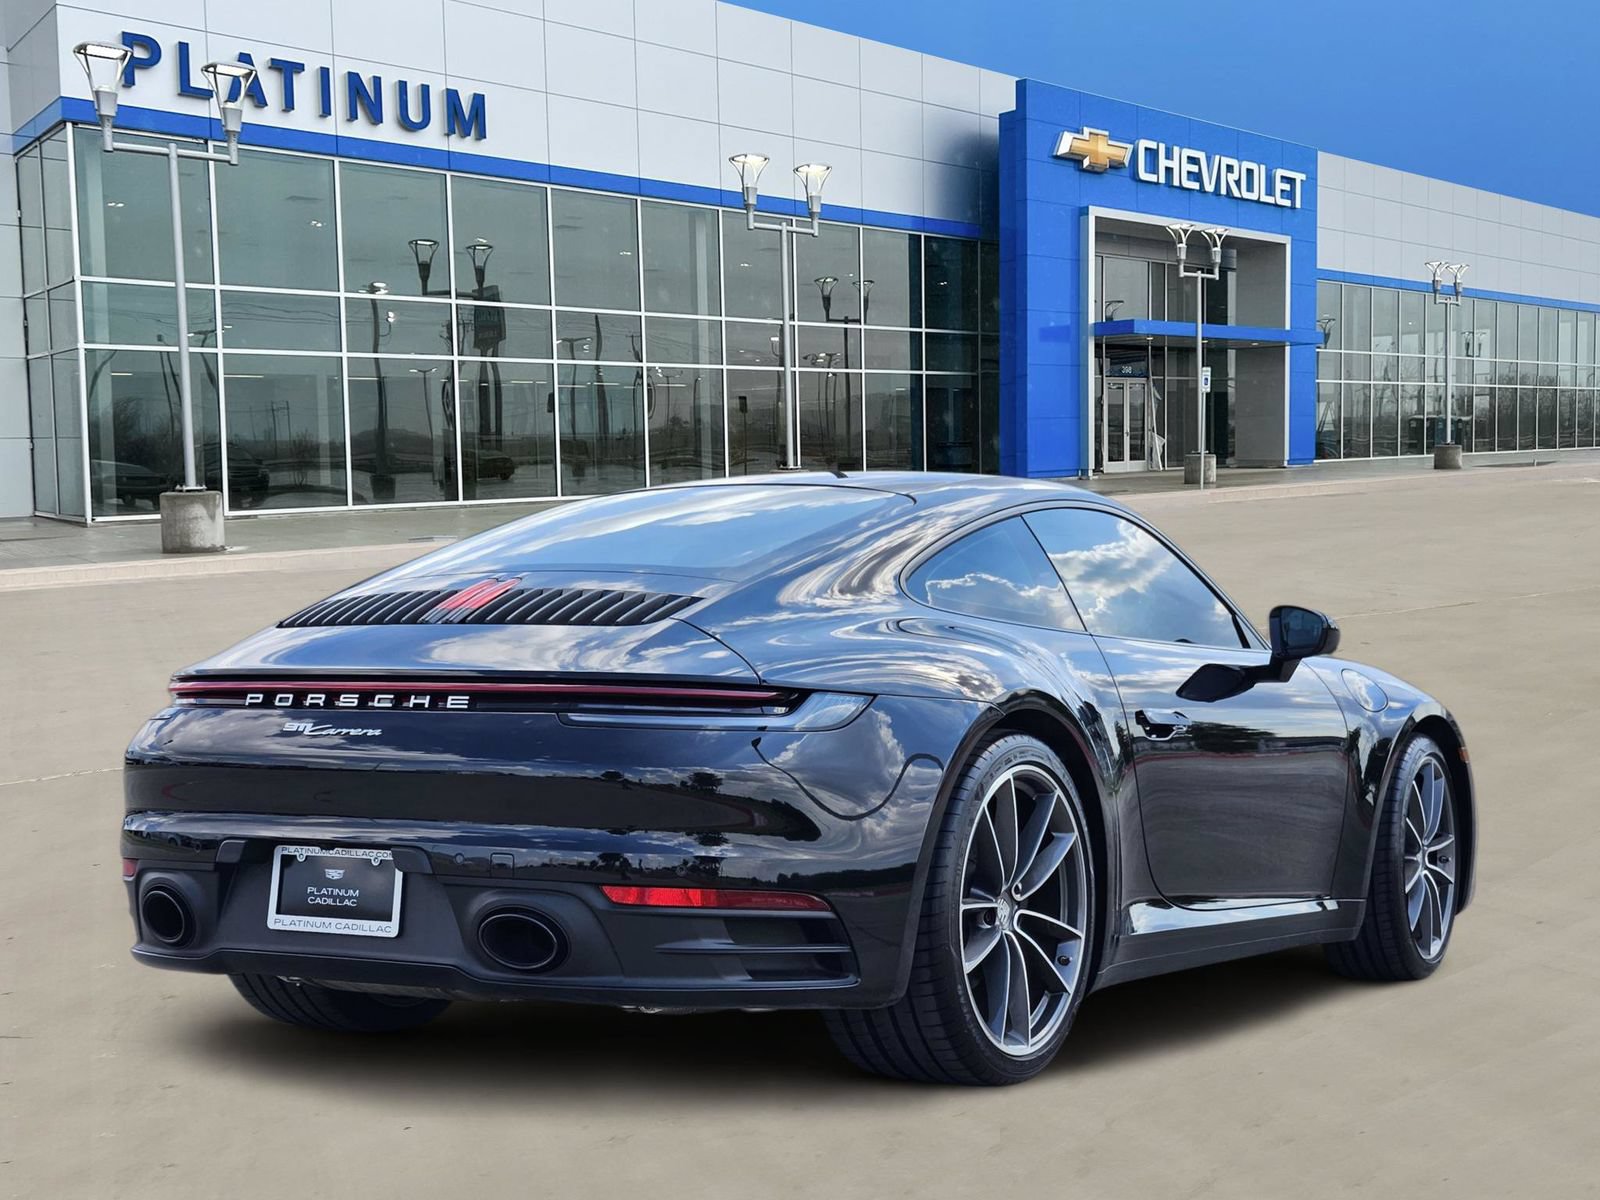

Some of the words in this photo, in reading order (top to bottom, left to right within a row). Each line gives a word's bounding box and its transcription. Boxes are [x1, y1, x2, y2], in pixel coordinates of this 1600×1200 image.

[121, 31, 487, 141] PLATINUM
[1136, 139, 1306, 209] CHEVROLET
[245, 693, 470, 708] PORSCHE
[303, 724, 383, 736] Carrera
[307, 886, 360, 897] PLATINUM
[307, 896, 358, 907] CADILLAC
[273, 918, 332, 929] PLATINUM
[334, 922, 392, 933] CADILLAC
